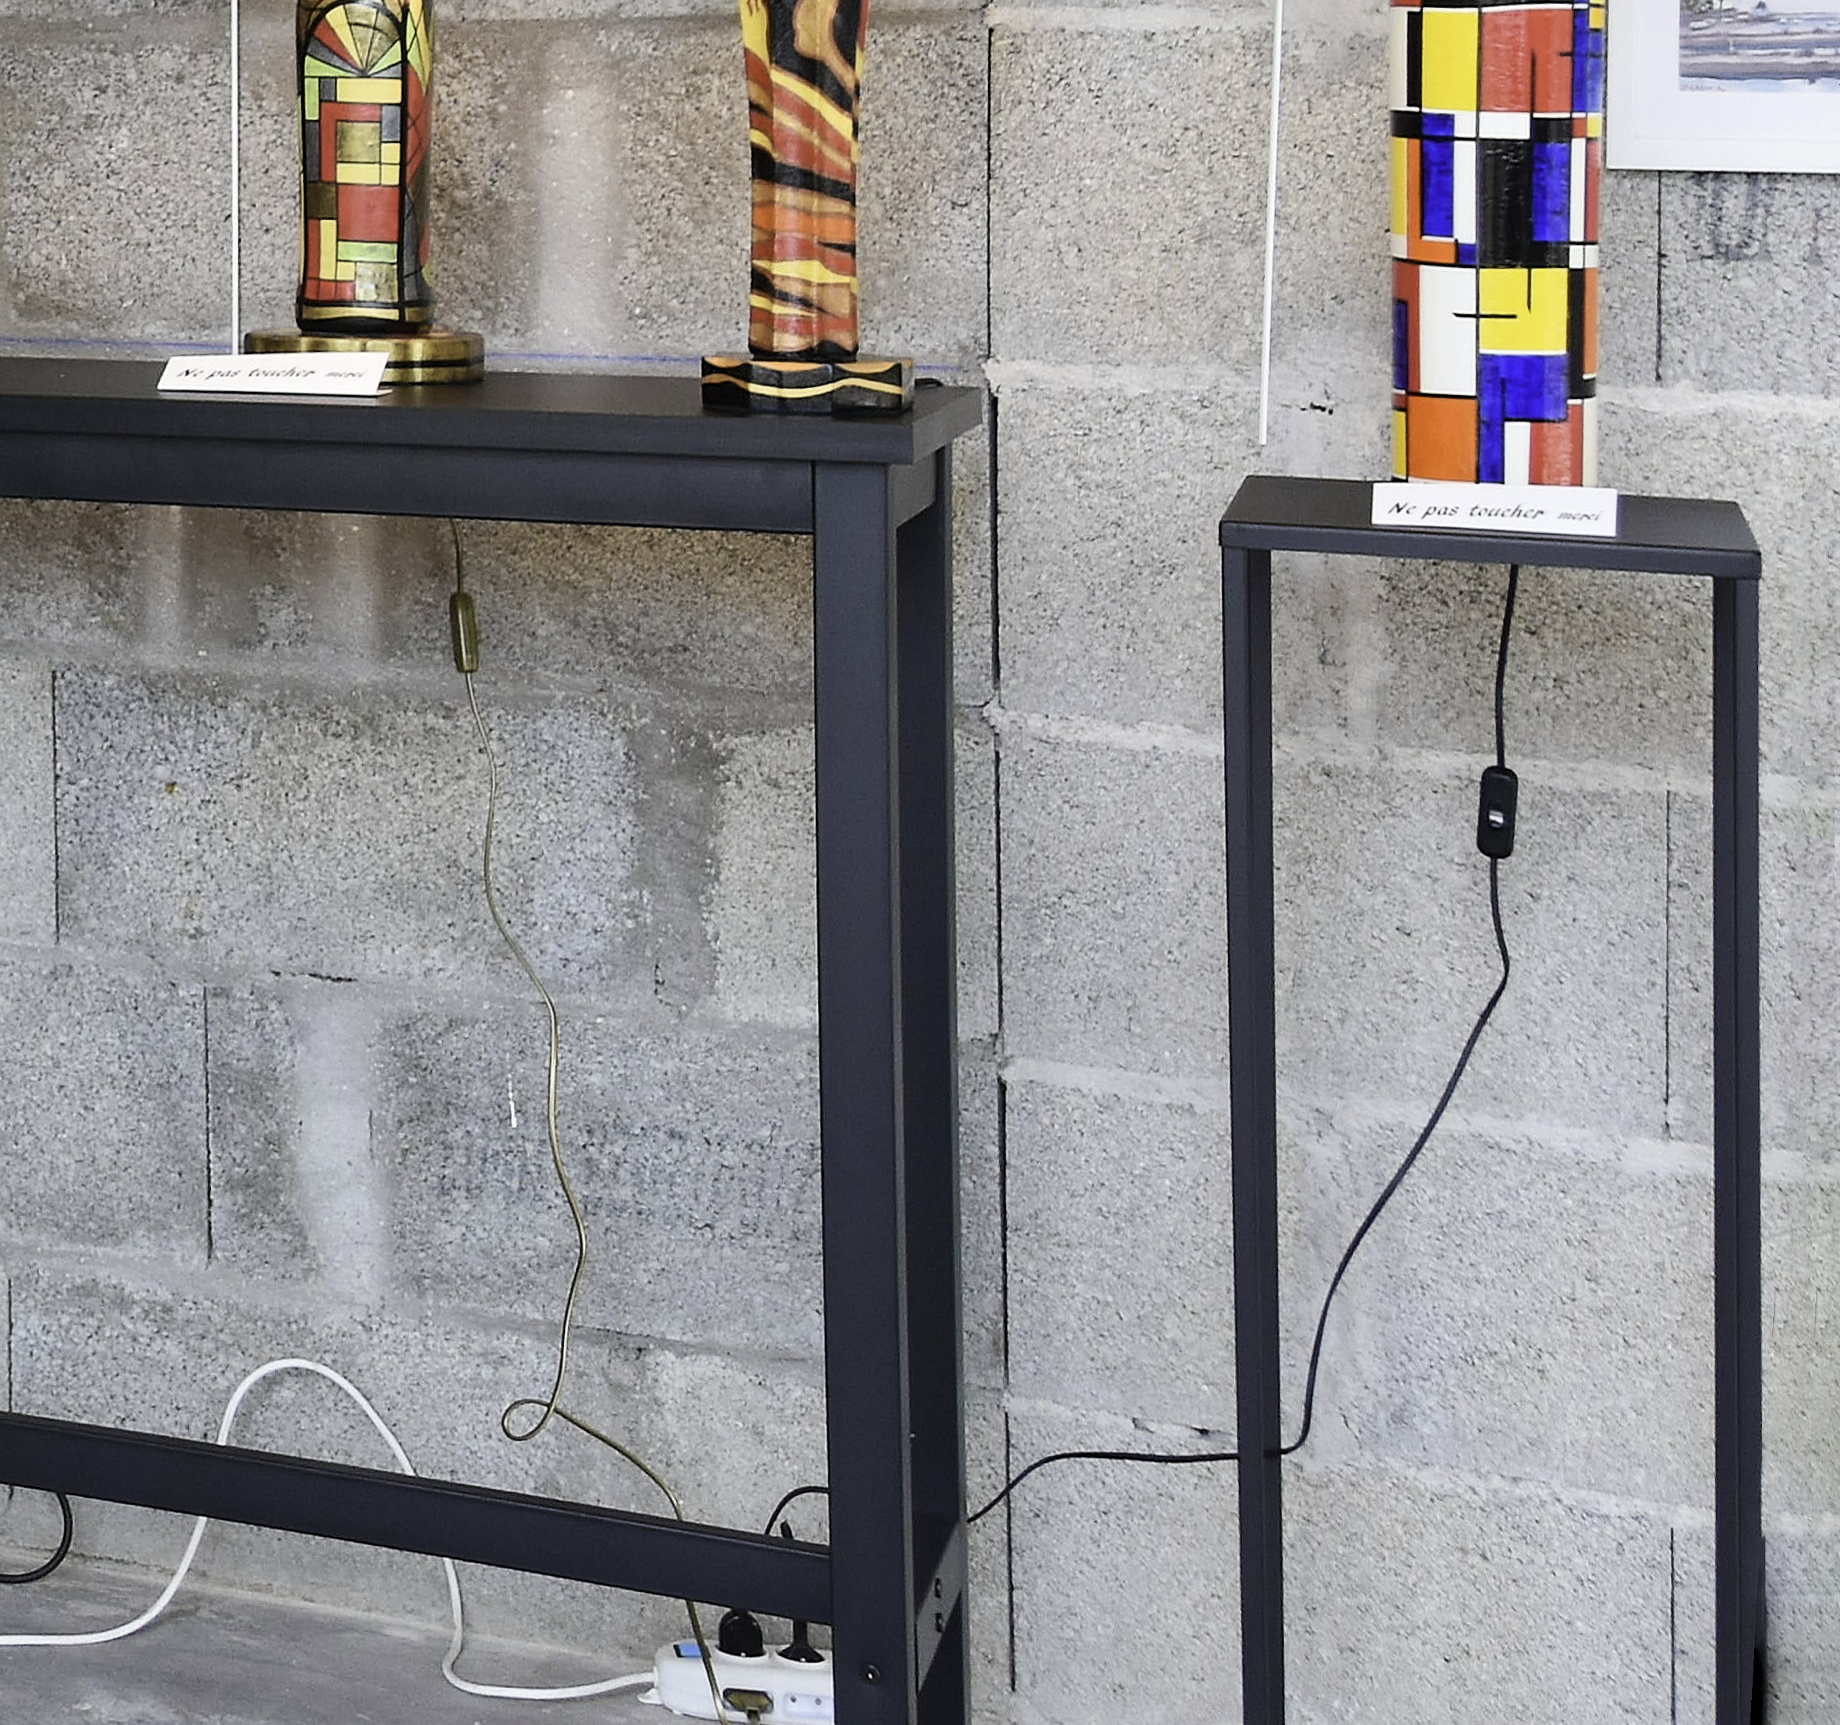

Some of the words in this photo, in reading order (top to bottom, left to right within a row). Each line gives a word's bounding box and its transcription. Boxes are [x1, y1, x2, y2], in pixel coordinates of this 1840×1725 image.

[177, 368, 203, 378] Ne
[206, 368, 242, 381] pas
[247, 365, 316, 379] toucher
[1387, 501, 1418, 516] Ne
[1421, 504, 1461, 520] pas
[1469, 501, 1546, 520] toucher
[1556, 509, 1604, 523] merci
